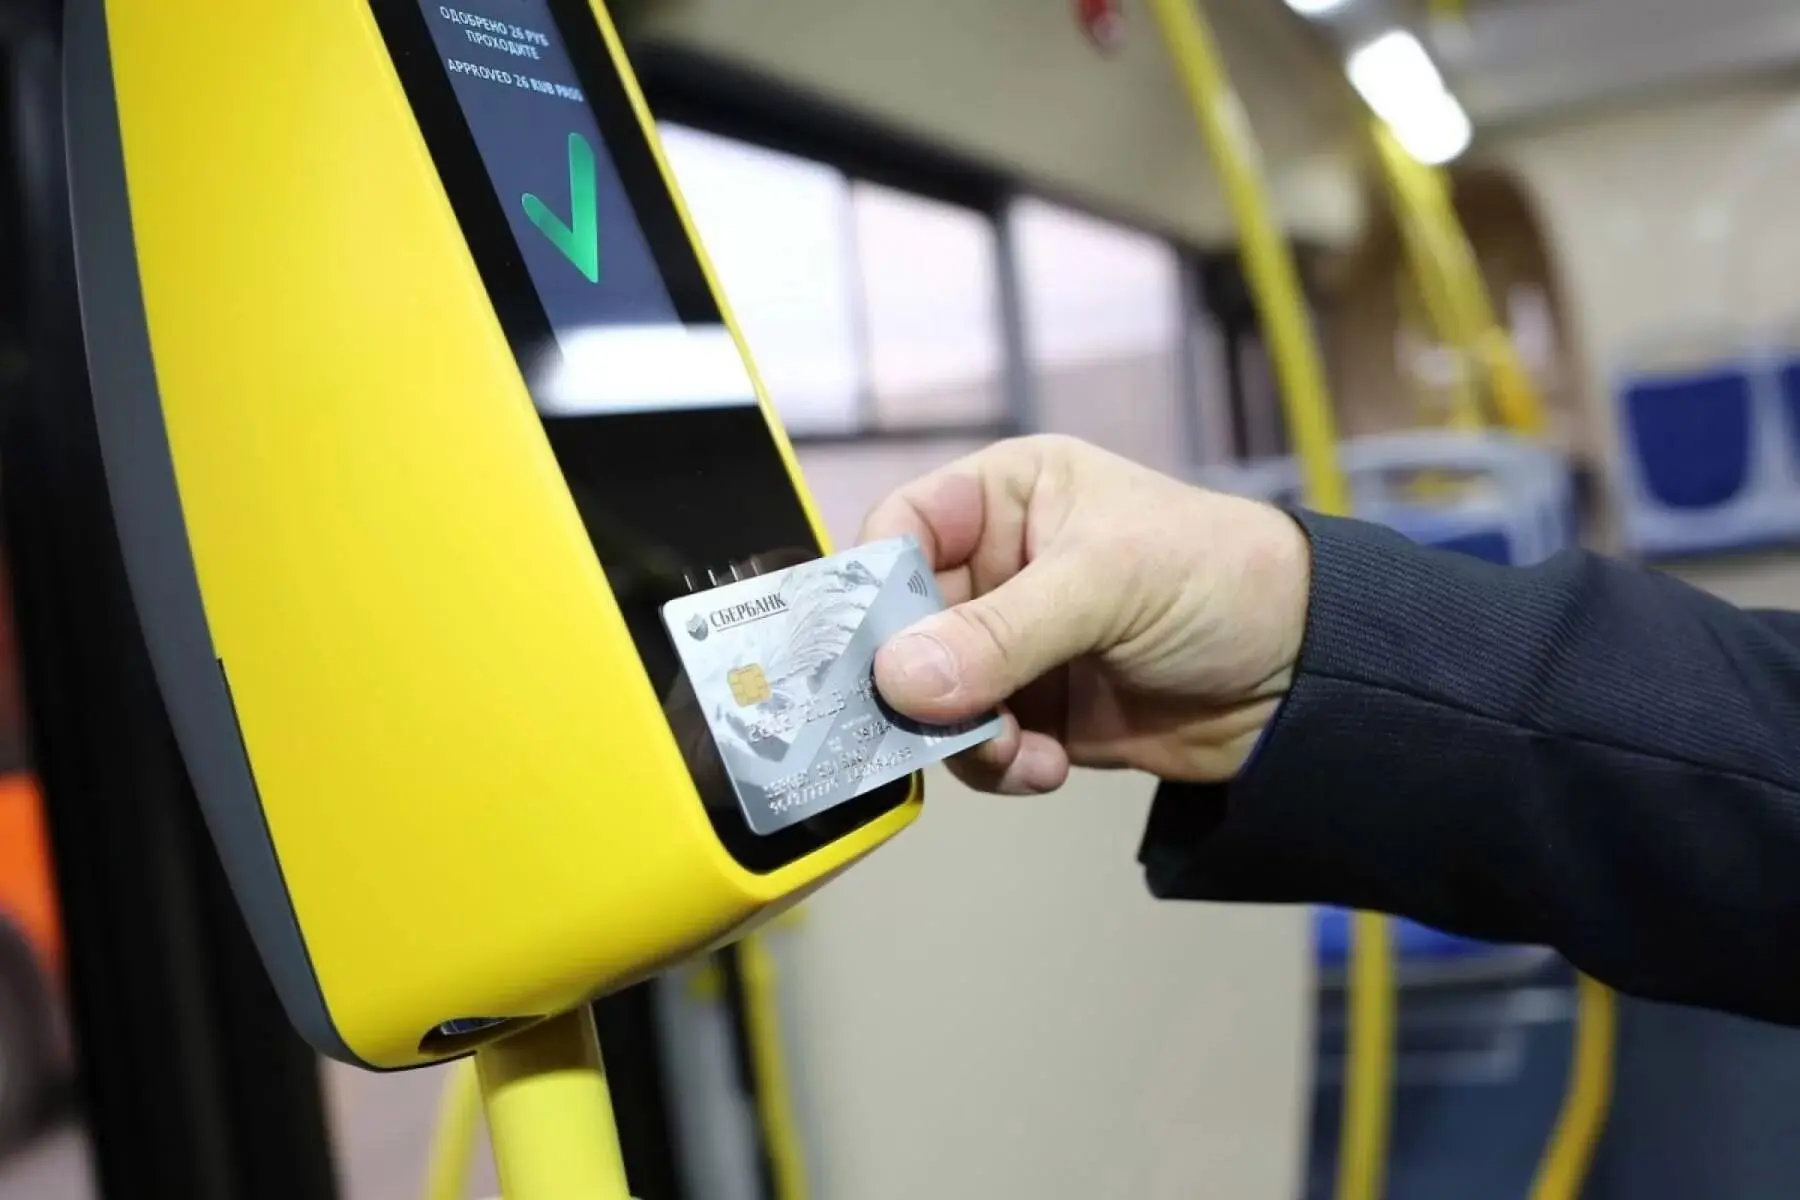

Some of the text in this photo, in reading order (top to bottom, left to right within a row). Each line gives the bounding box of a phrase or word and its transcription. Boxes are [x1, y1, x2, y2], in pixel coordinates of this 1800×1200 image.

[439, 5, 549, 47] ОДОБРЕНО 26 РУБ
[464, 29, 541, 60] ПРОХОДИТЕ
[447, 58, 512, 84] APPROVED
[513, 74, 530, 90] 26
[709, 592, 787, 628] СБЕРБАНК
